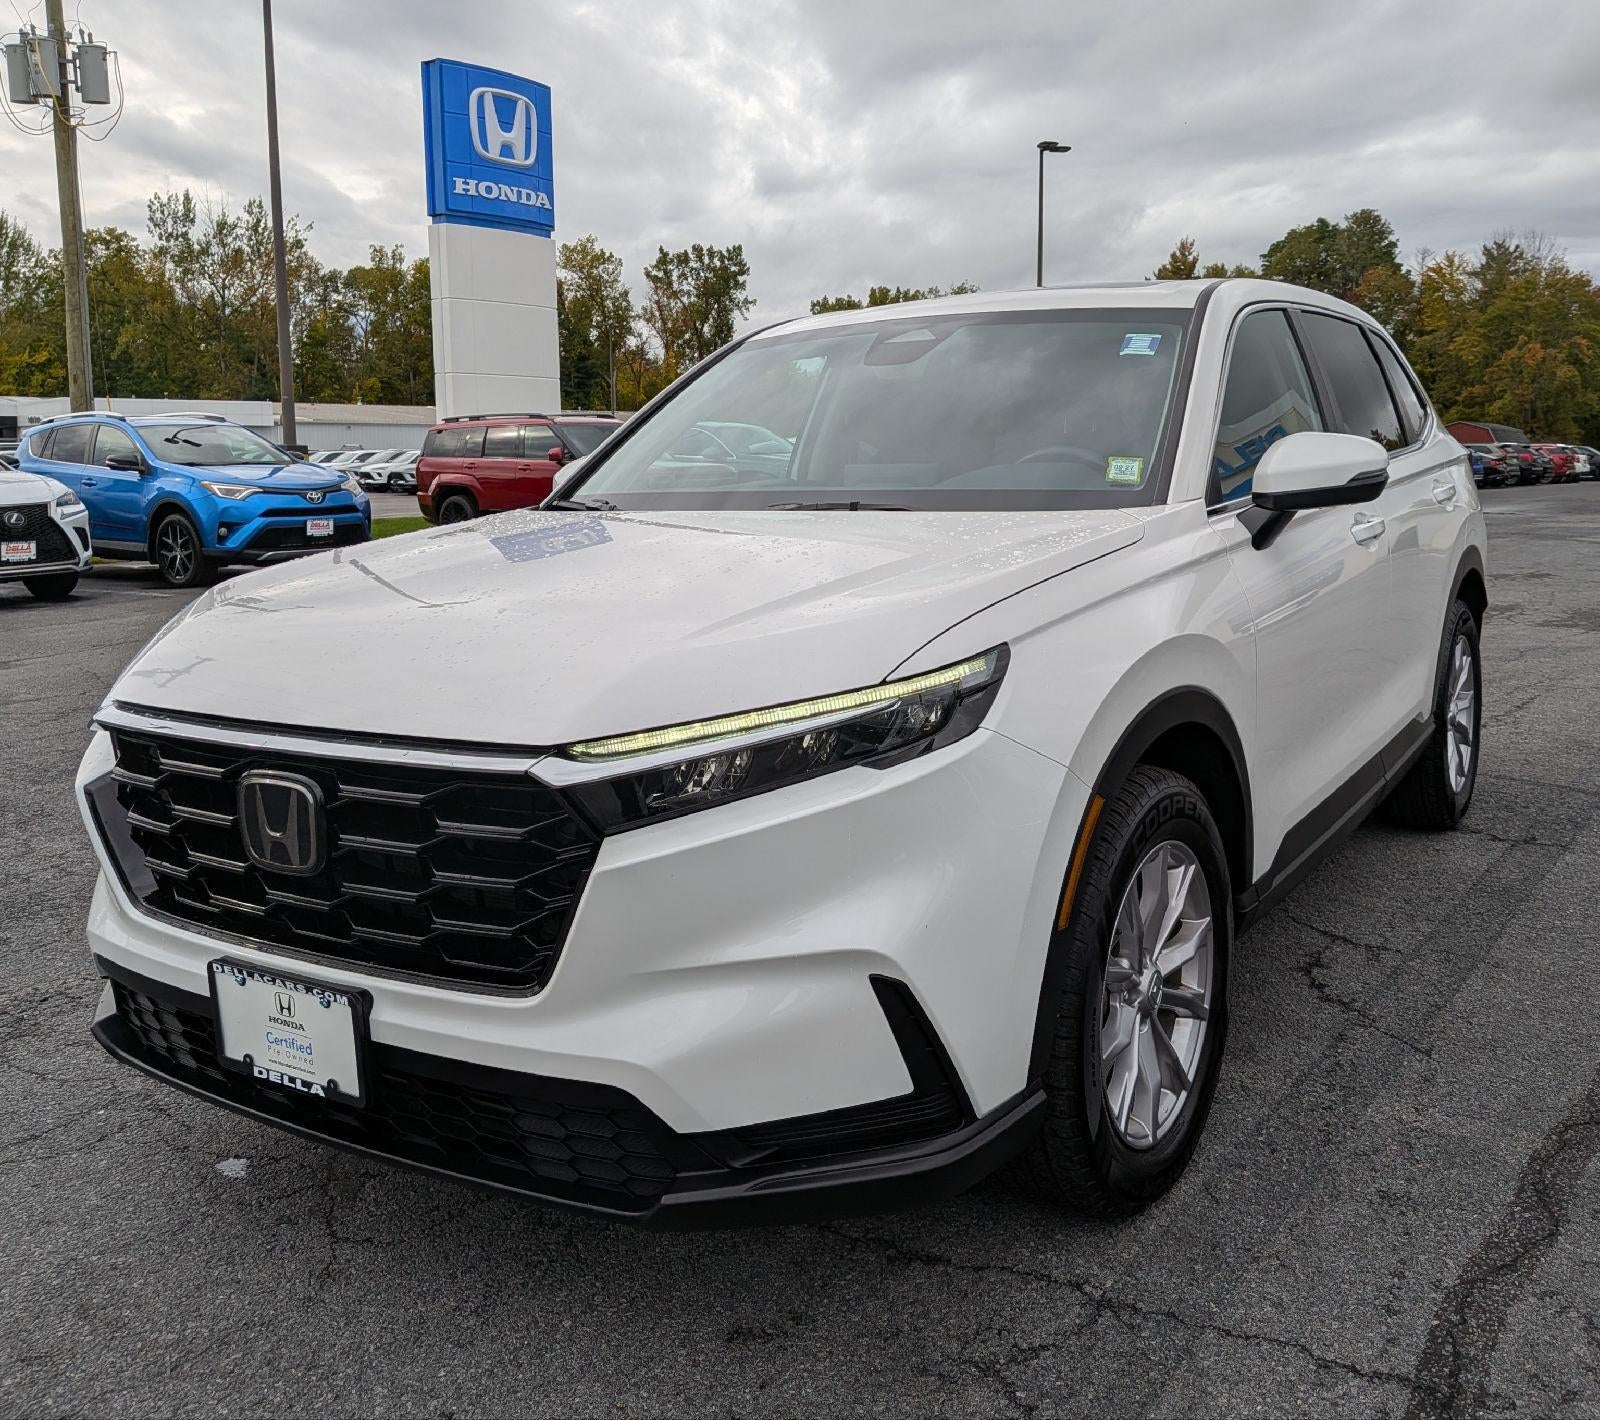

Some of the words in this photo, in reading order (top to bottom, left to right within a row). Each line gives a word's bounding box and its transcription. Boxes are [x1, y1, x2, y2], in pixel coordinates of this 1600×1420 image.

[452, 177, 553, 210] HONDA
[212, 962, 348, 1005] DELLACARS.COM
[268, 1015, 306, 1032] HONDA
[266, 1031, 313, 1056] Certified
[253, 1065, 326, 1098] DELLA
